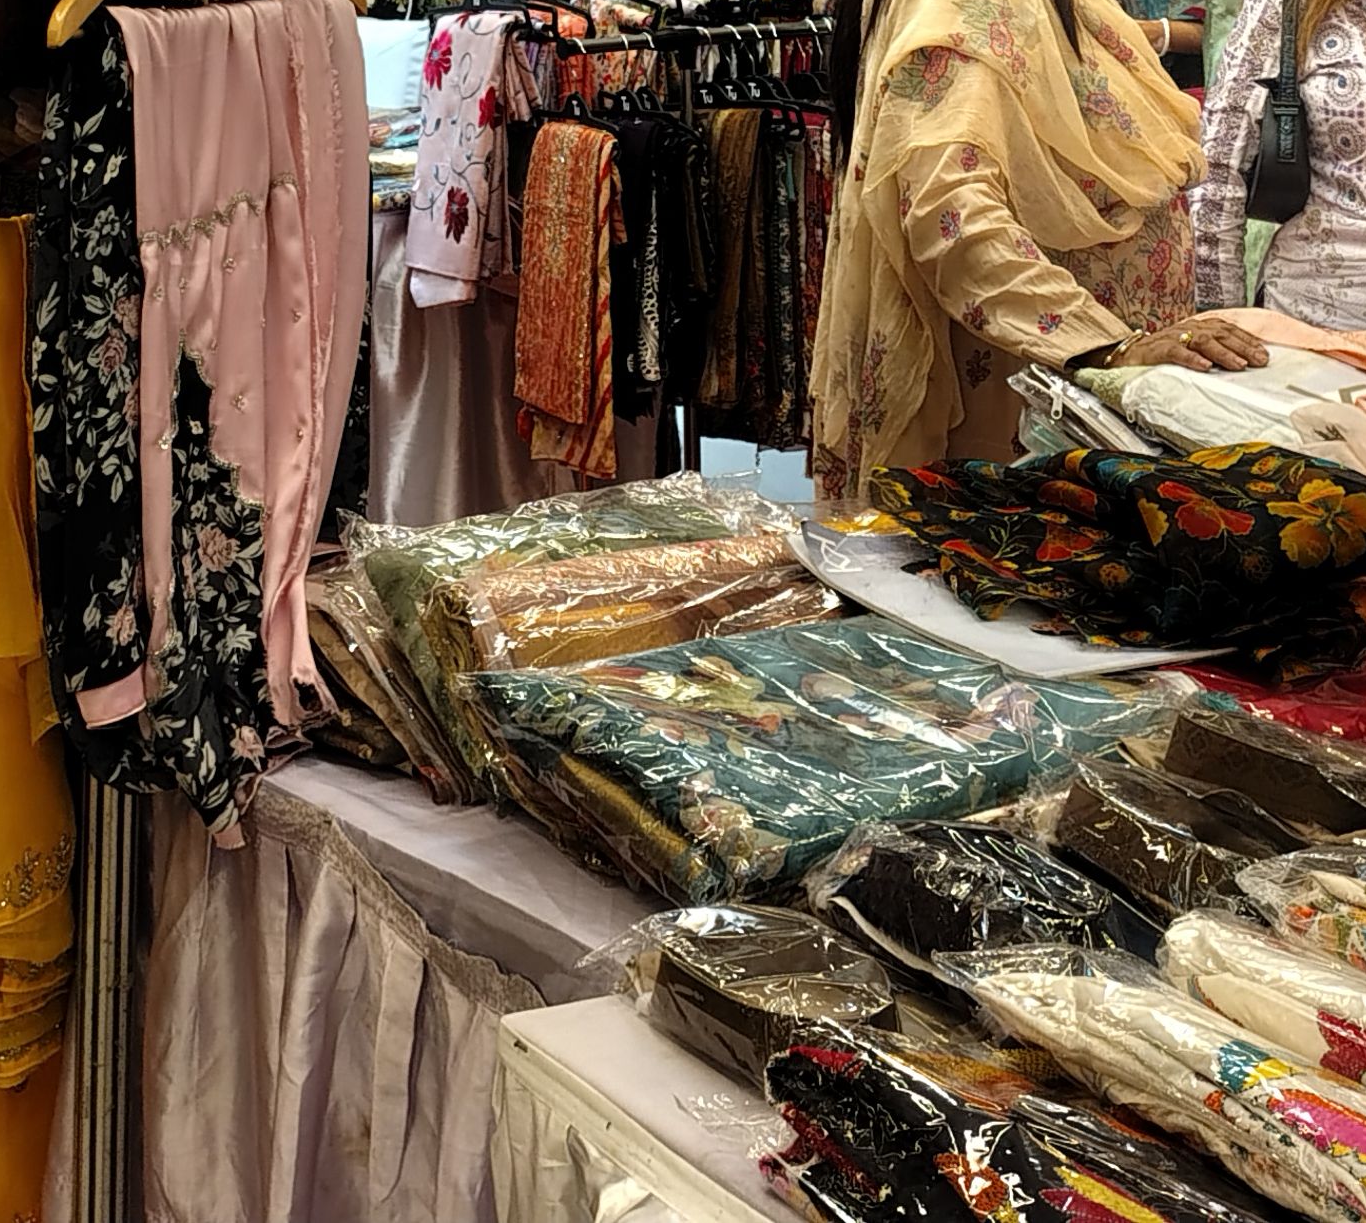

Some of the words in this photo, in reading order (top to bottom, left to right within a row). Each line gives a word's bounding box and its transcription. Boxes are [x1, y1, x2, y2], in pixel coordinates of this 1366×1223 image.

[699, 89, 714, 105] Tu
[725, 85, 738, 101] Tu
[747, 82, 761, 98] Tu
[620, 95, 631, 112] Tu
